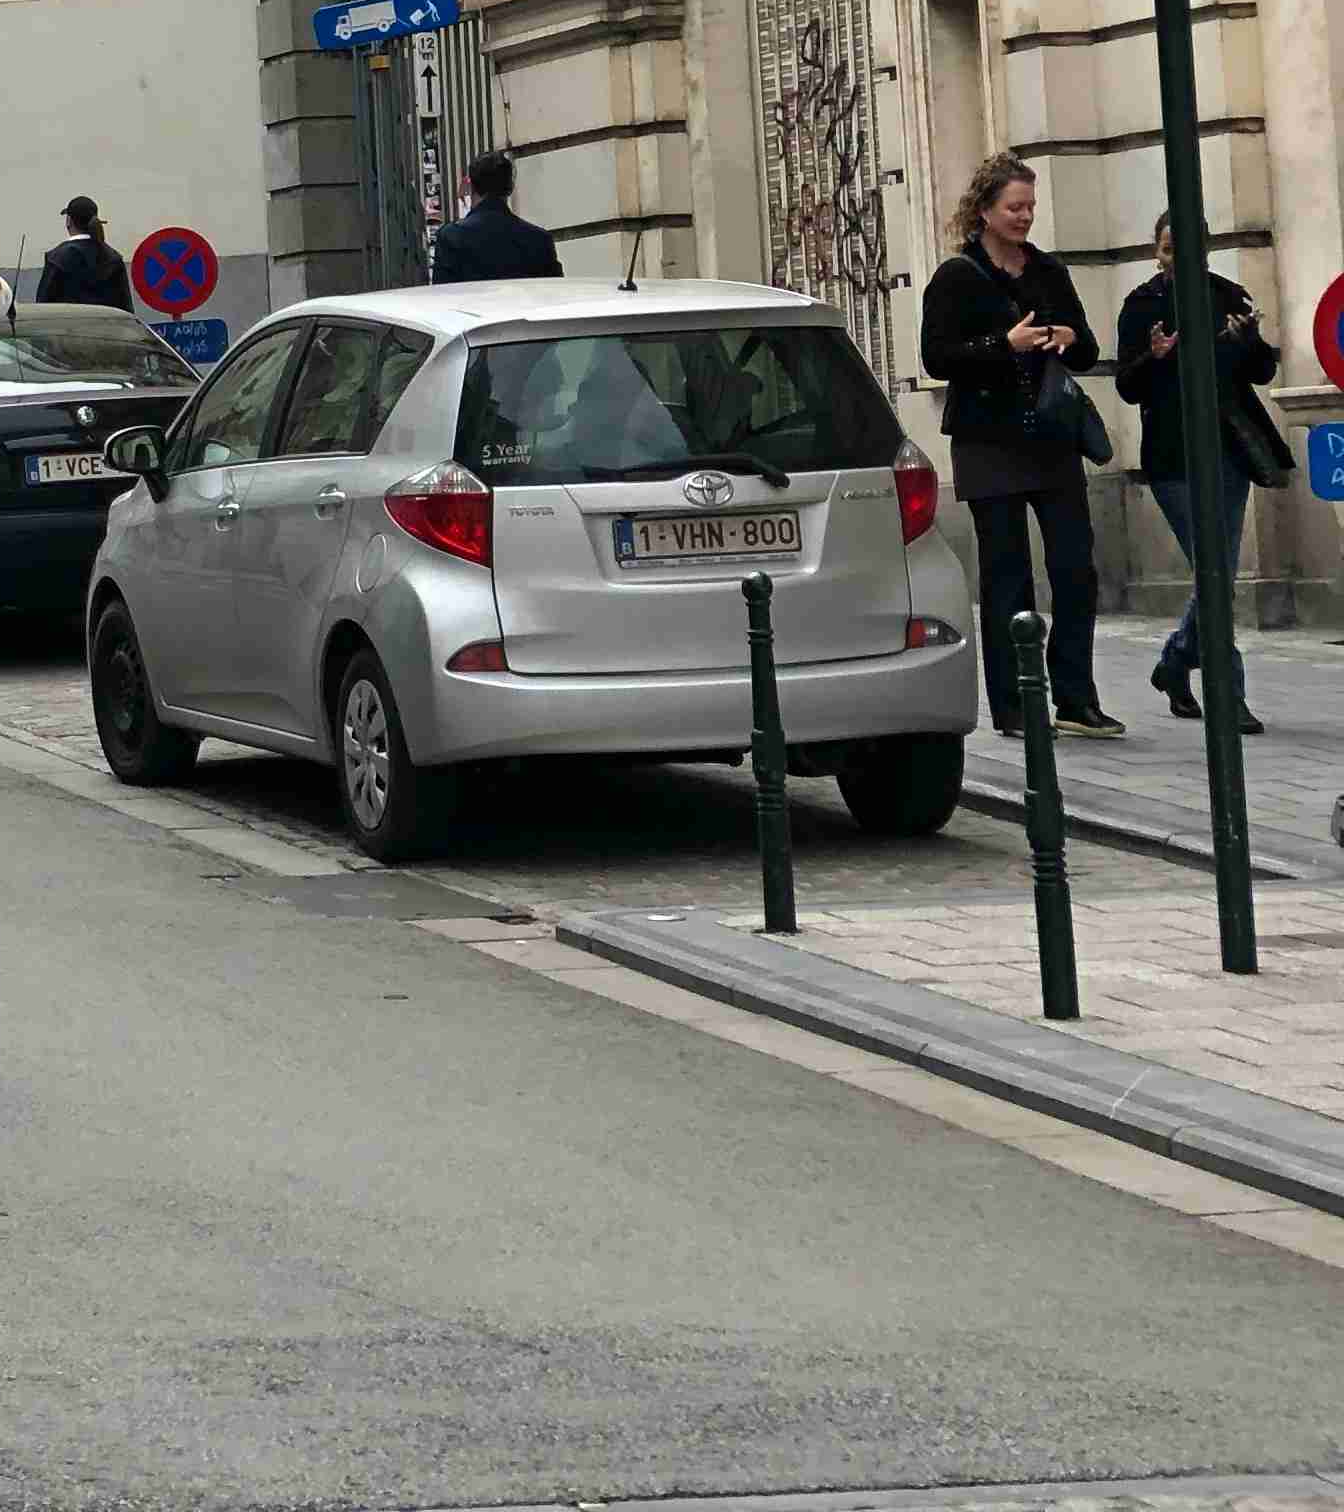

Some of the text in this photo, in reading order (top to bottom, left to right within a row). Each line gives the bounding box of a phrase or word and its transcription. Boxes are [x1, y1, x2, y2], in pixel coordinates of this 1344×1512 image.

[420, 38, 435, 49] 12
[481, 443, 530, 458] 5 Year
[481, 454, 532, 467] warranty
[638, 517, 795, 552] 1-VHN-800
